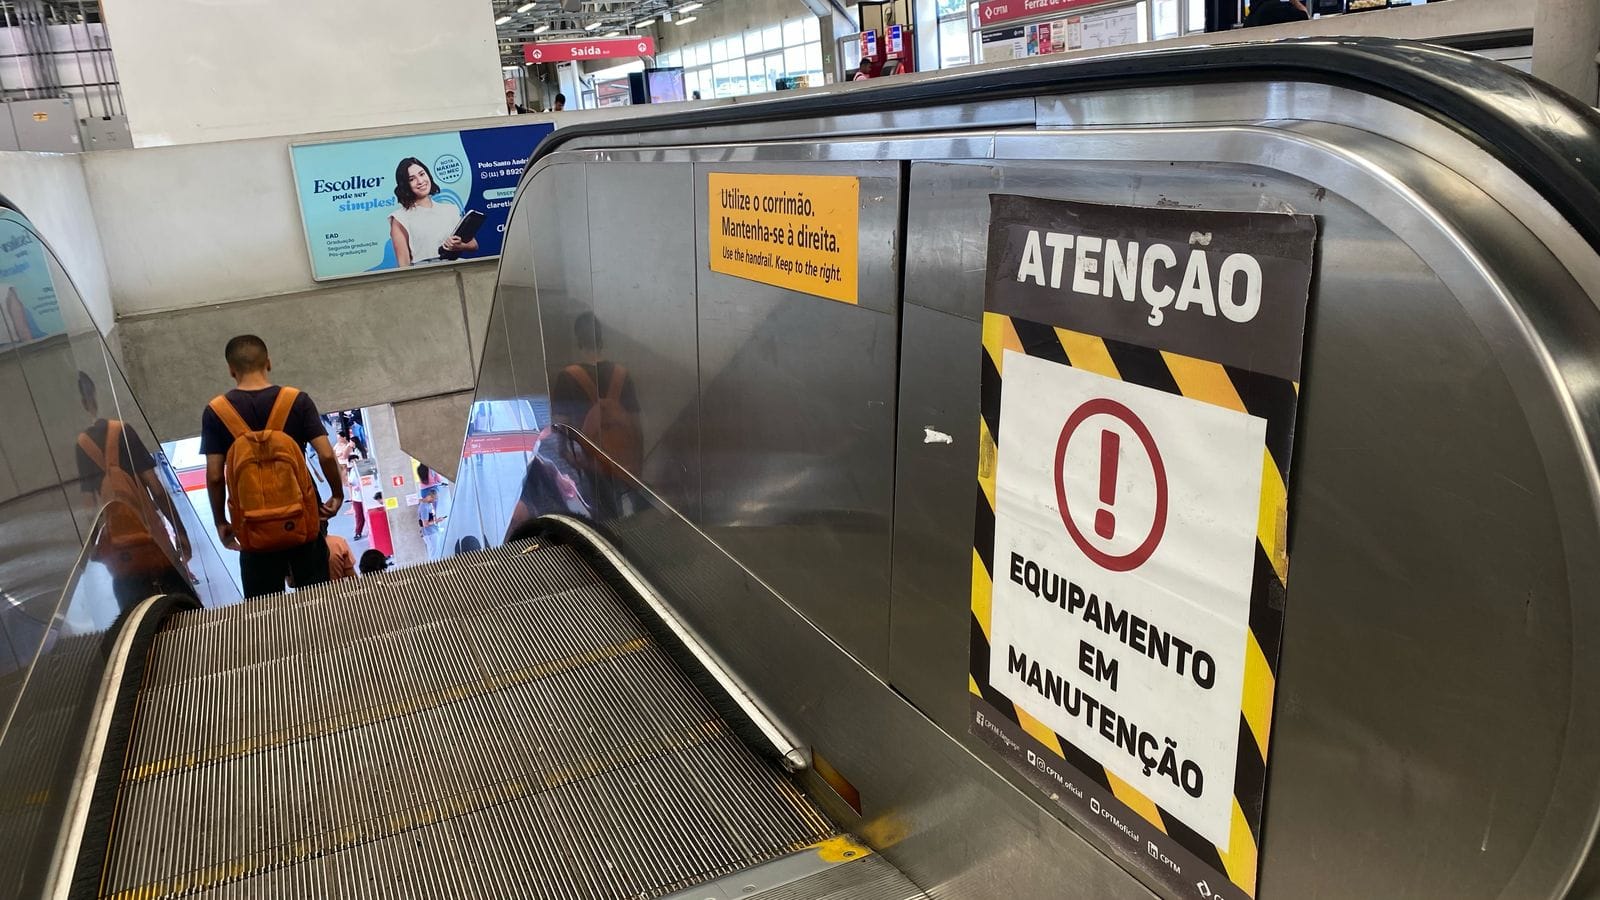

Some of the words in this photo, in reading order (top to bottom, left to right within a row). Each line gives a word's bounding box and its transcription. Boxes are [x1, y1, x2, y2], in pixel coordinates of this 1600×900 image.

[313, 176, 385, 194] Escolher
[332, 192, 353, 202] pode
[721, 188, 750, 210] Utilize
[753, 195, 759, 212] o
[762, 191, 815, 217] corrimão.
[338, 196, 396, 212] simples!
[722, 216, 784, 245] Mantenha-se
[787, 222, 794, 246] à
[797, 223, 840, 253] direita.
[722, 246, 733, 260] Use
[734, 247, 744, 262] the
[745, 249, 774, 268] handrail.
[775, 255, 793, 275] Keep
[795, 259, 803, 274] to
[805, 260, 818, 276] the
[819, 263, 842, 283] right.
[1016, 230, 1263, 327] ATENÇÃO
[1010, 551, 1216, 690] EQUIPAMENTO
[1078, 639, 1119, 692] EM
[1008, 644, 1204, 799] MANUTENÇÃO
[1101, 808, 1140, 843] CPTMoficial
[1160, 854, 1181, 875] CPTM
